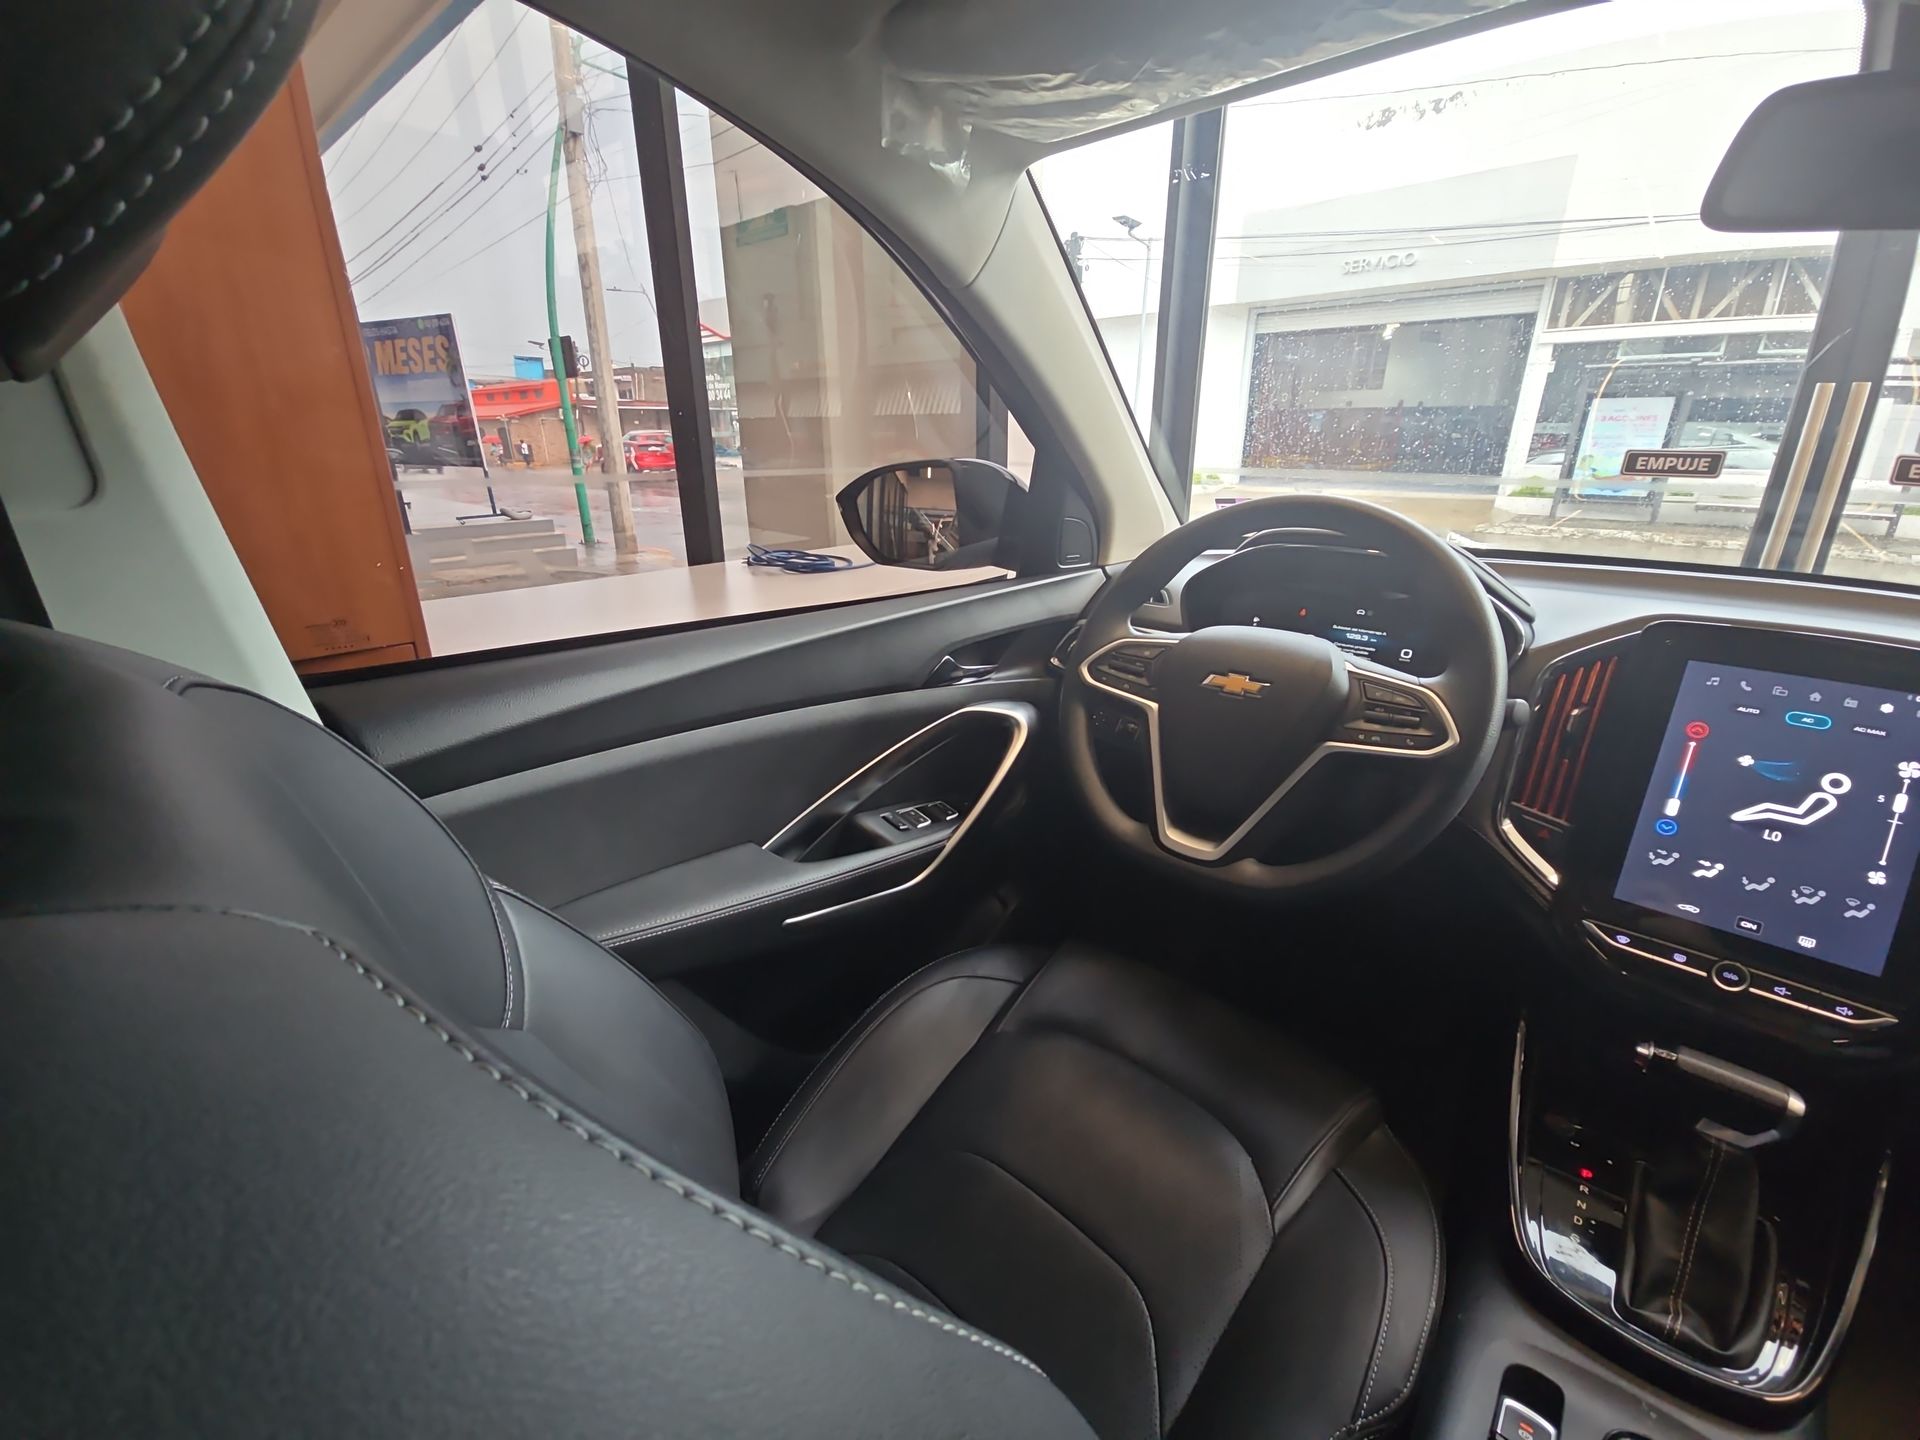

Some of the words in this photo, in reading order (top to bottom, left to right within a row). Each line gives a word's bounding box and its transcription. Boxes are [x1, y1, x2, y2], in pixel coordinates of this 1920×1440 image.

[1342, 252, 1417, 275] SERVICIO
[374, 335, 449, 375] MESES
[1635, 456, 1712, 471] EMPUJE
[1737, 706, 1760, 714] AUTO
[1867, 728, 1887, 736] MAX
[1740, 920, 1757, 930] ON
[1580, 1184, 1589, 1195] R
[1577, 1200, 1587, 1210] N
[1573, 1215, 1583, 1226] D
